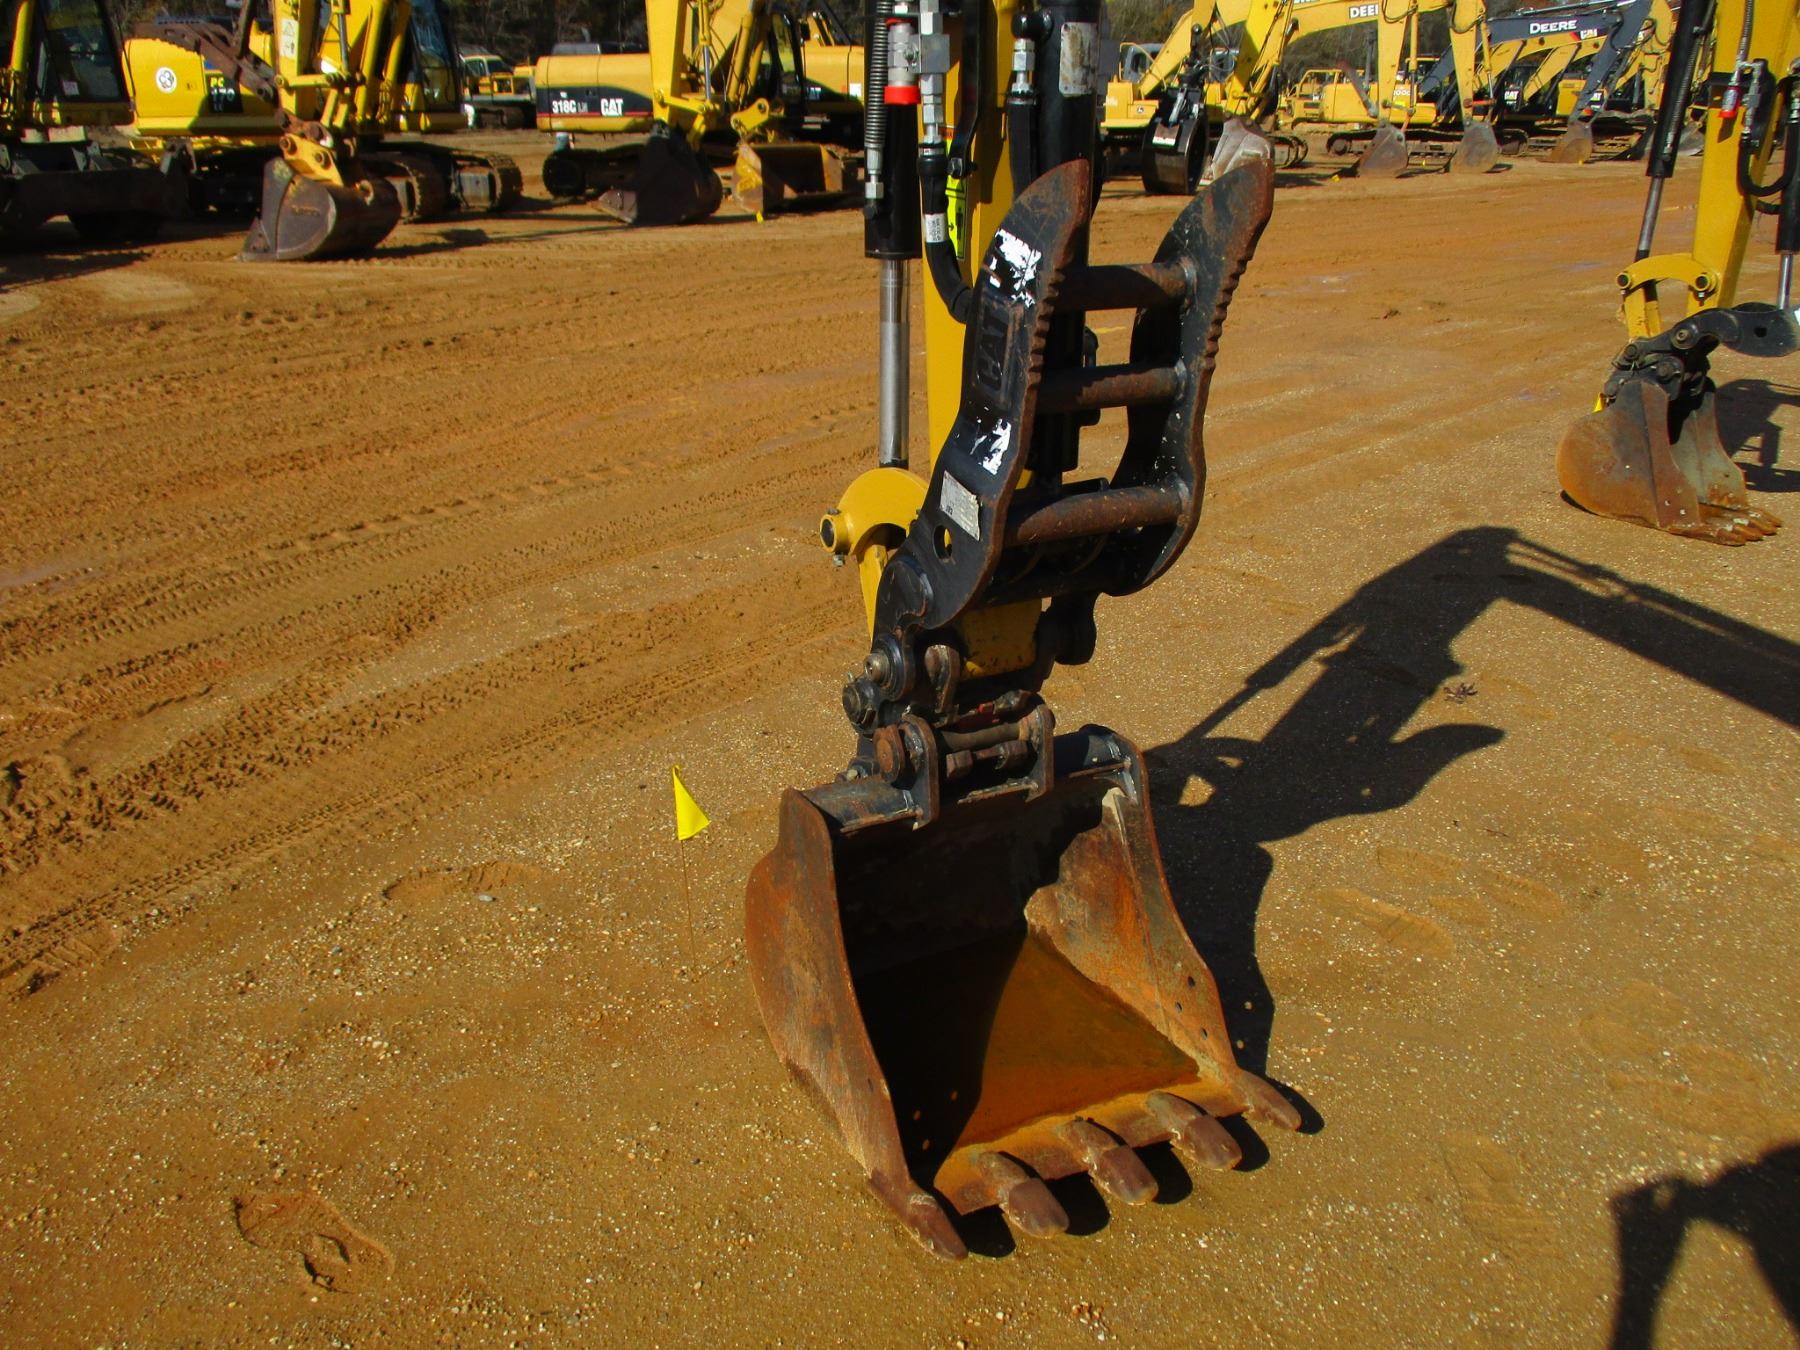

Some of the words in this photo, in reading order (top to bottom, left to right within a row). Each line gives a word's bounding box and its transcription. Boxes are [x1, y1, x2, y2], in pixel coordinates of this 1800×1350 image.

[1529, 20, 1577, 34] DEERE
[210, 77, 225, 88] PC
[1504, 90, 1519, 100] CAT
[552, 100, 577, 114] 318C
[601, 98, 624, 117] CAT
